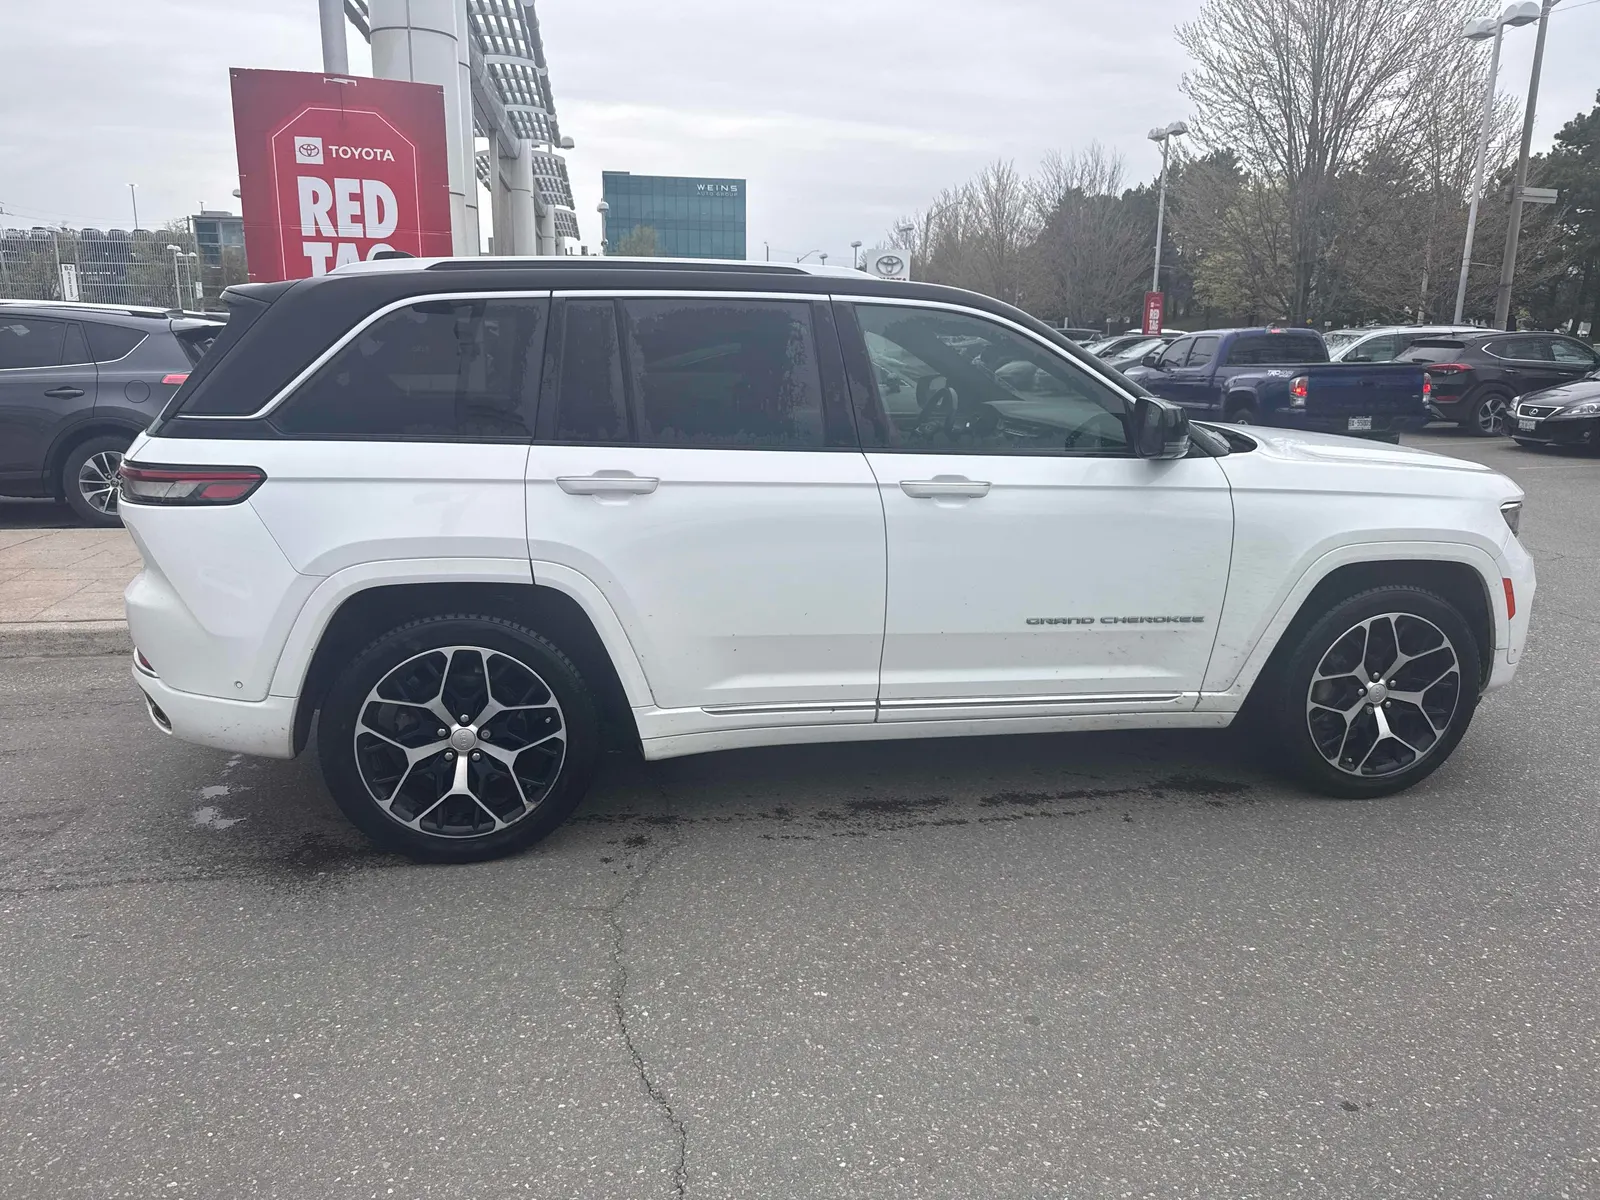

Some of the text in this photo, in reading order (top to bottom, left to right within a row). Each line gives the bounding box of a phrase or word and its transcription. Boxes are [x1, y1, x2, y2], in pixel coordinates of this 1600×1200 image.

[329, 146, 395, 161] TOYOTA
[297, 176, 398, 238] RED
[1149, 309, 1159, 319] RED
[1026, 616, 1205, 625] GRAND CHEROKEE
